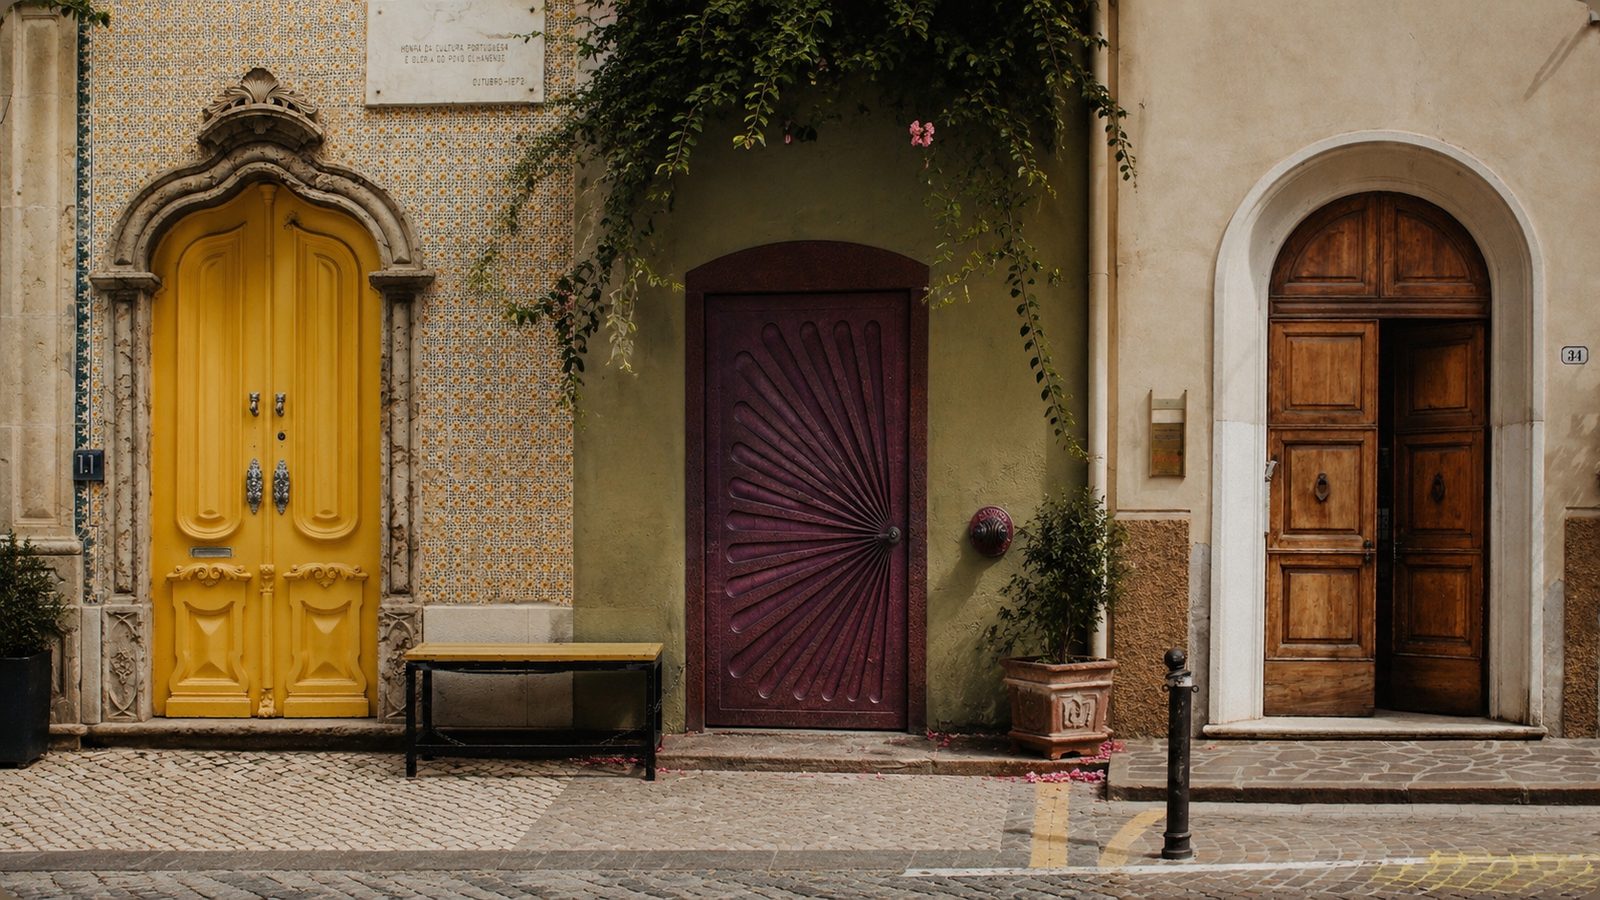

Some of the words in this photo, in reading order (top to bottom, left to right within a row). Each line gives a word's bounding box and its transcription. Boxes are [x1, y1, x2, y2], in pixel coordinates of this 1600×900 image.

[400, 45, 422, 53] HONRA
[435, 44, 464, 52] CULTURA
[467, 43, 509, 52] PORTUGUESA
[1568, 349, 1581, 361] 34
